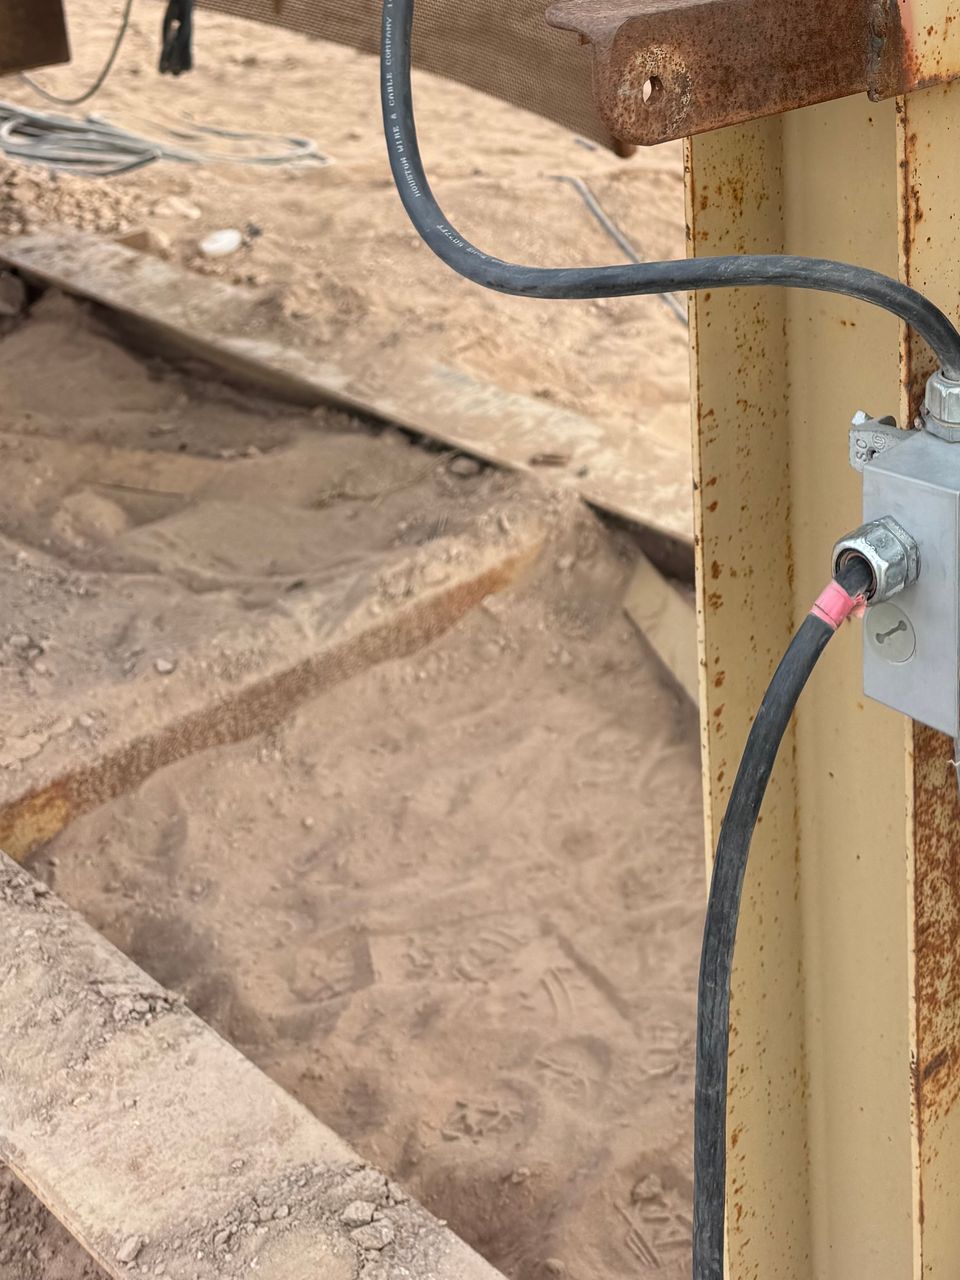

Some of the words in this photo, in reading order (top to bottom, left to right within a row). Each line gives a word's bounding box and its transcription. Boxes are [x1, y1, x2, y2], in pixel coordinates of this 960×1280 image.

[386, 72, 395, 107] CABLE
[393, 126, 404, 153] WIRE
[400, 157, 421, 197] HOUSTON
